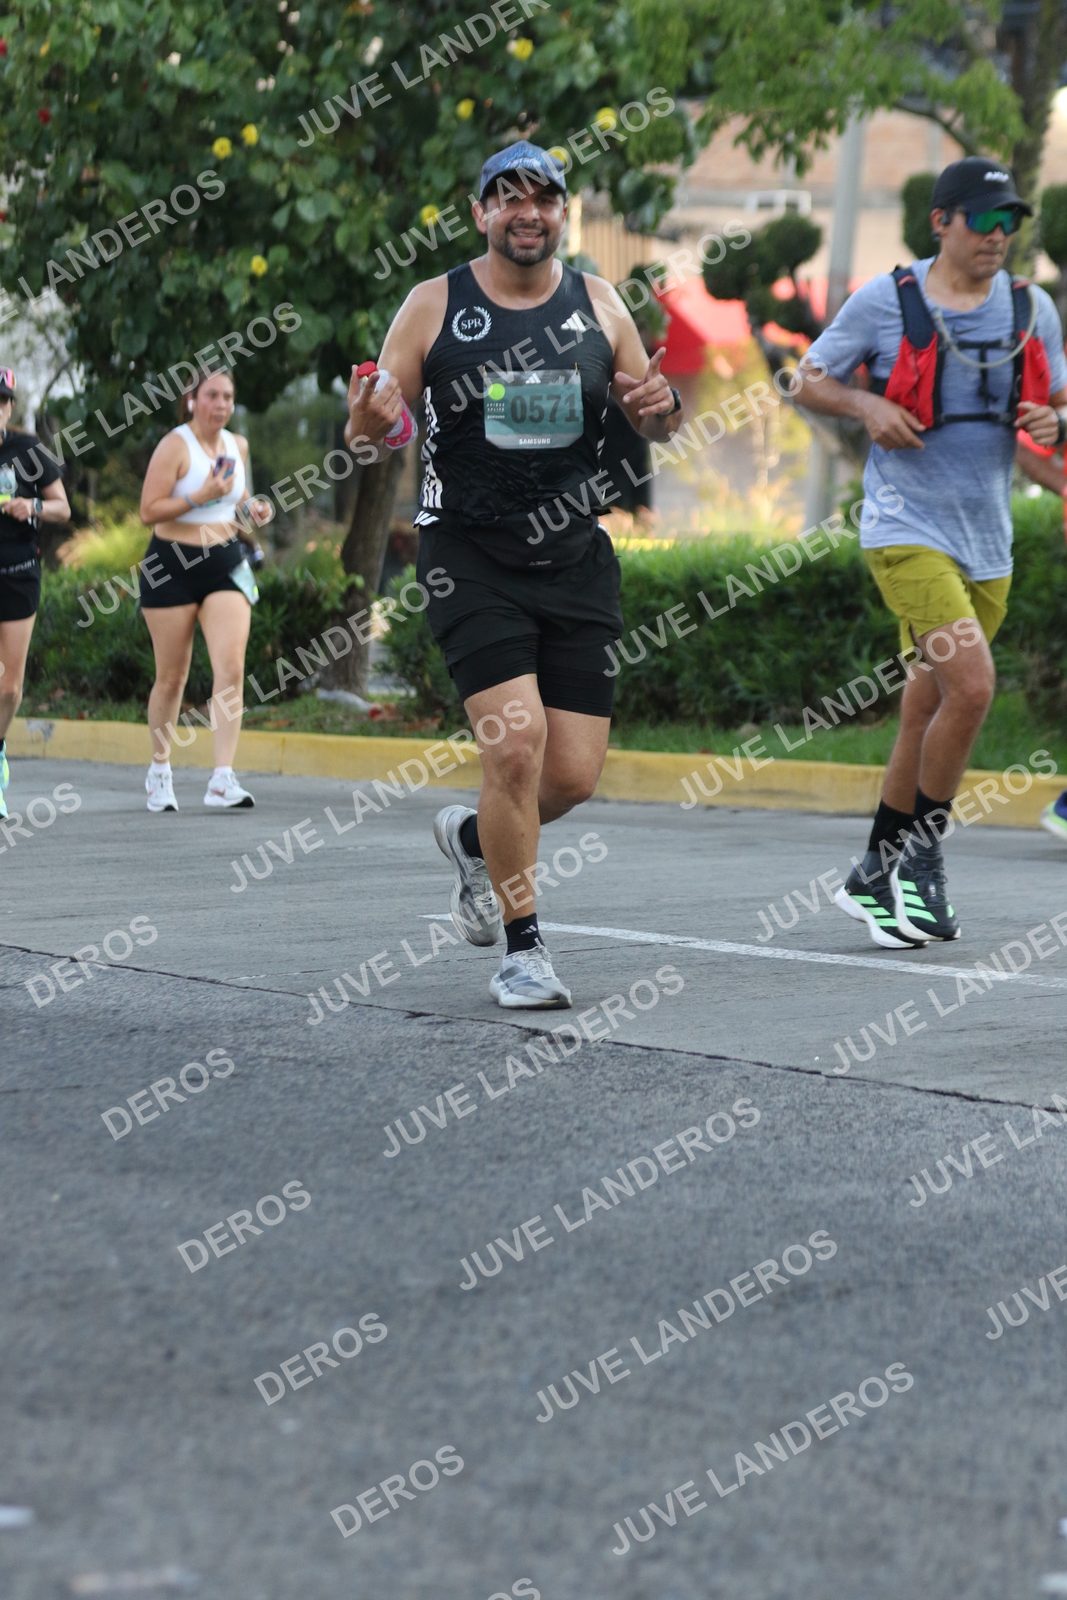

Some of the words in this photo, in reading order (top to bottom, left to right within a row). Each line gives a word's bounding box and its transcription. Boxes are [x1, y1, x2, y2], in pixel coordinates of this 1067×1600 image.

[461, 318, 483, 330] SPR
[511, 393, 579, 424] 0571
[518, 437, 551, 445] SAMSUNG
